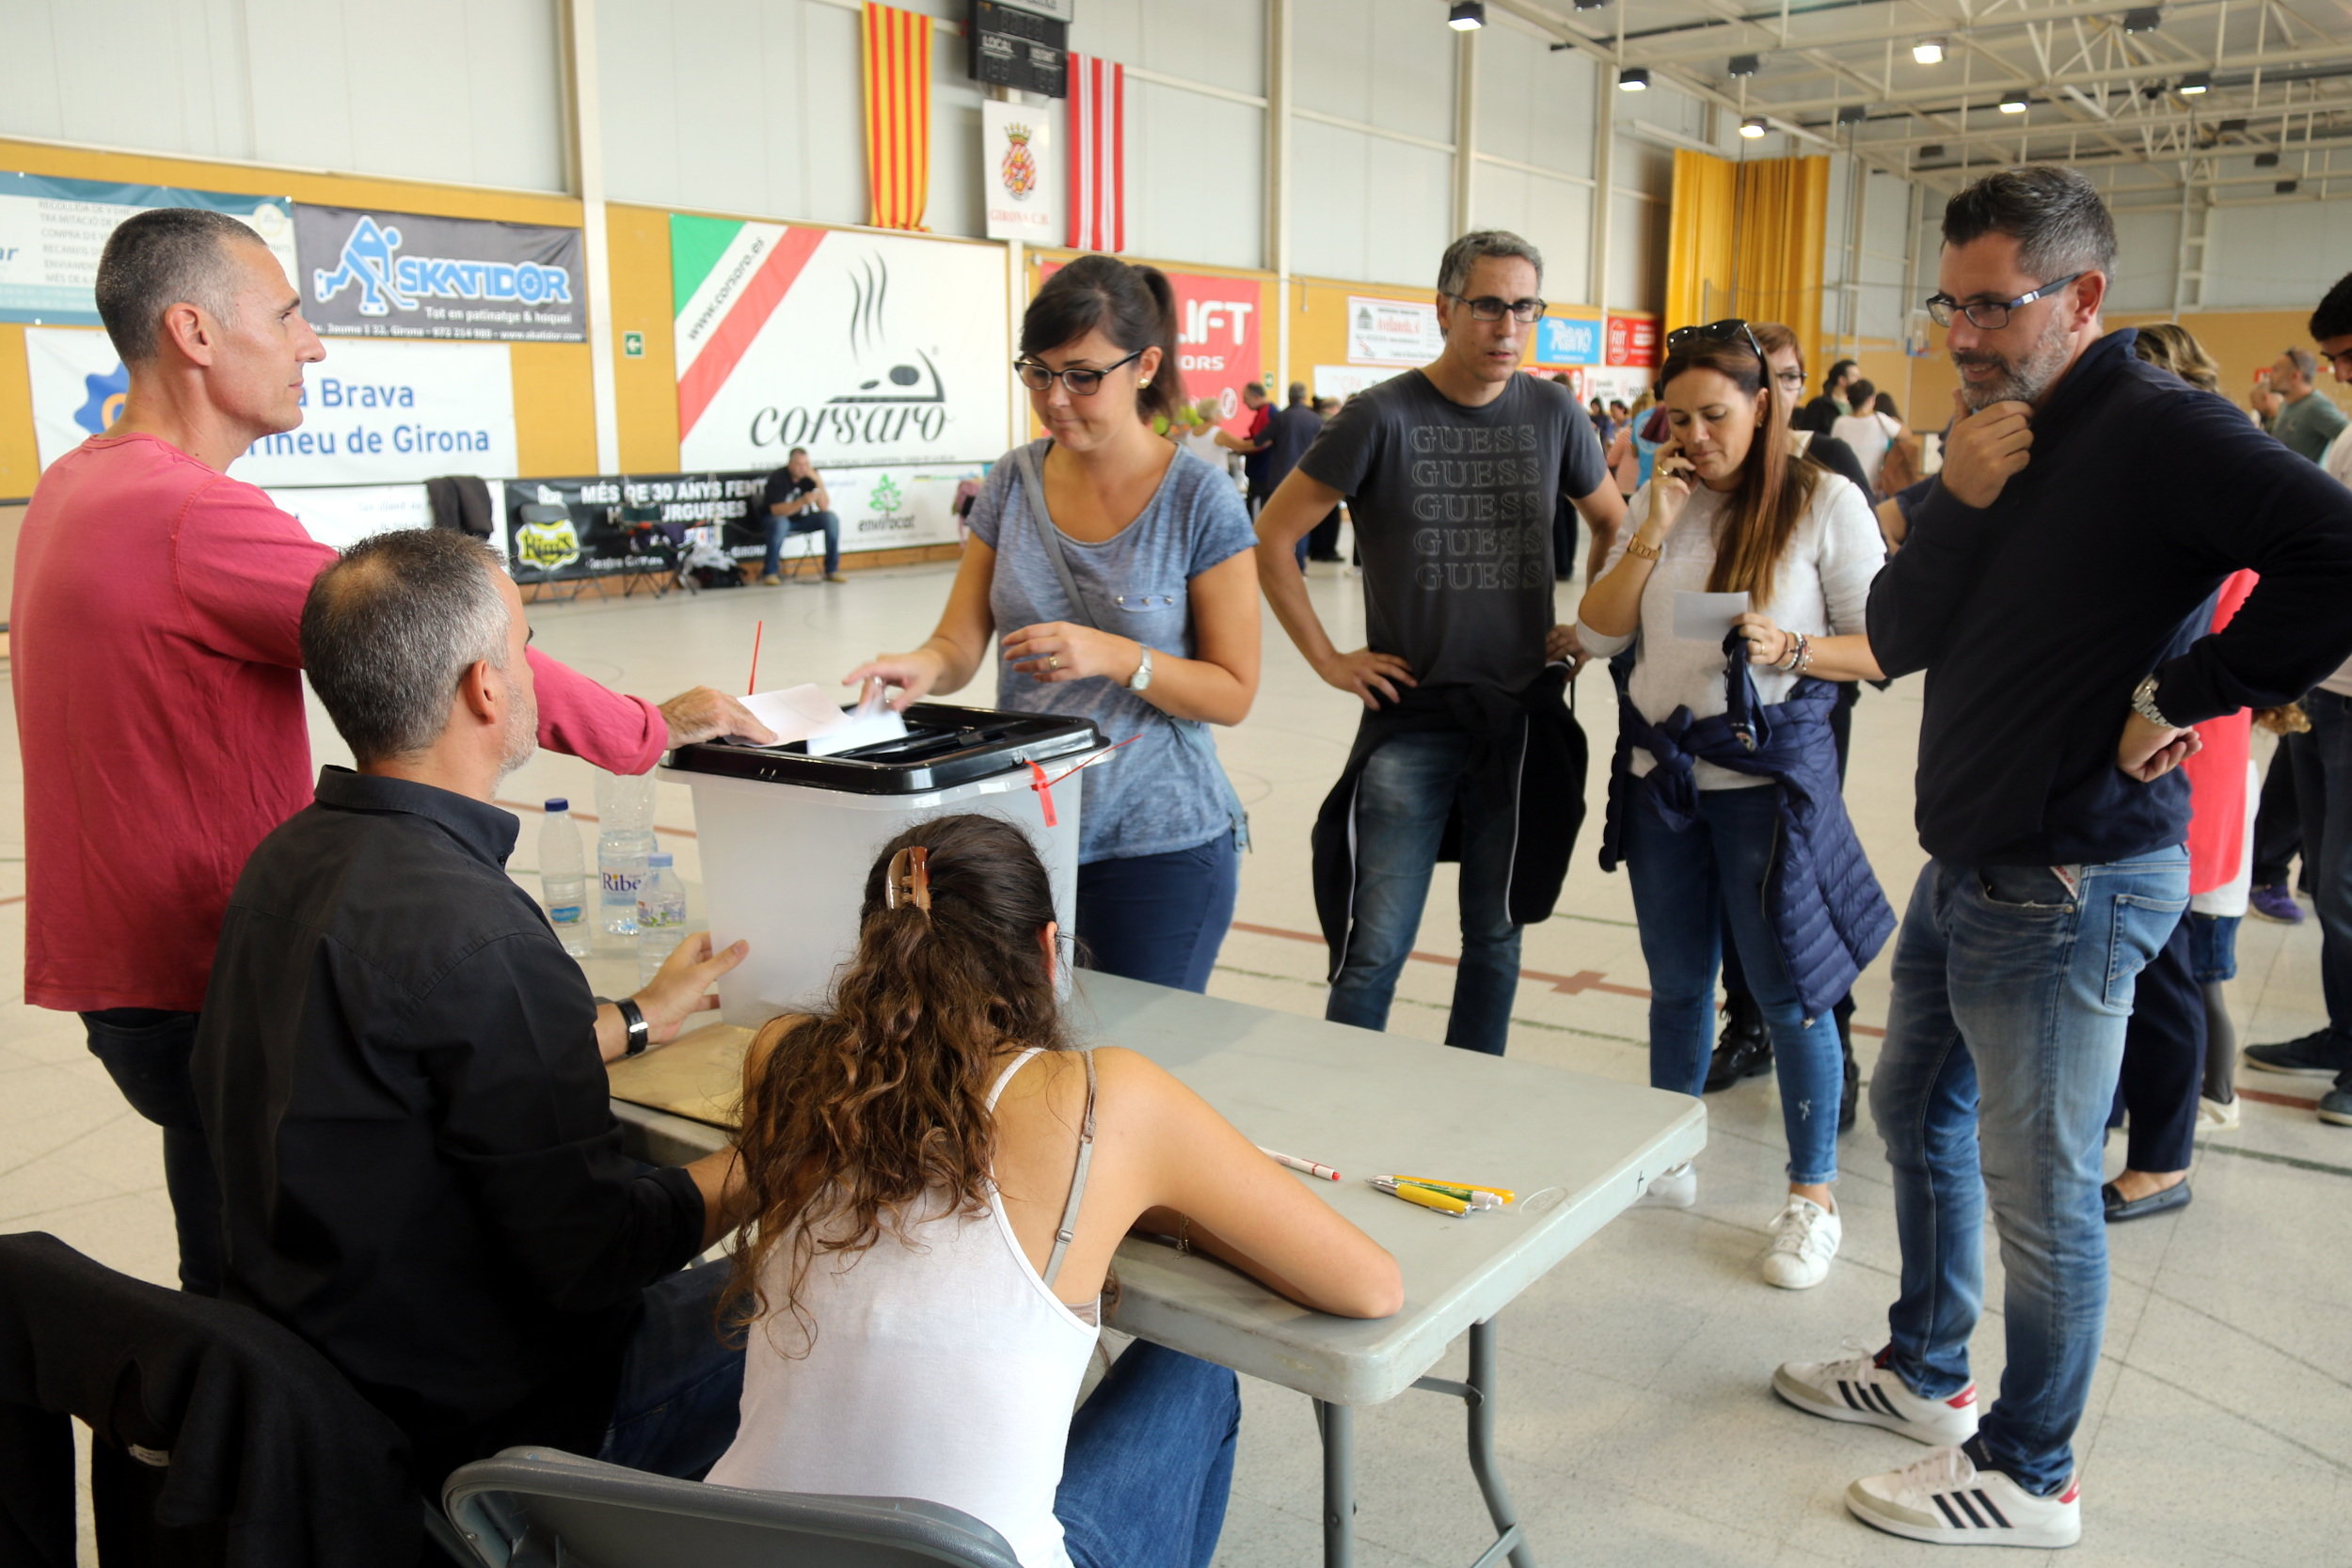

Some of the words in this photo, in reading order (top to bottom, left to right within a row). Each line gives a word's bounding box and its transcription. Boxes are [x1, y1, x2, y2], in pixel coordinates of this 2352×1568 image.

[982, 35, 1013, 55] LOCAL
[991, 208, 1026, 223] GIRONA
[396, 256, 573, 304] SKATIDOR
[688, 237, 765, 341] www.corsaro.es
[424, 306, 447, 320] Tot
[448, 309, 464, 321] en
[465, 309, 521, 325] patinatge
[523, 310, 532, 323] &
[534, 311, 573, 325] hoquei
[1178, 299, 1253, 346] IFT
[327, 323, 363, 335] Jaume
[389, 325, 424, 337] Girona
[500, 329, 582, 341] www.skatidor.com
[322, 378, 415, 407] Brava
[347, 426, 384, 454] de
[393, 424, 490, 453] Girona
[750, 404, 948, 447] corsaro
[1410, 424, 1537, 453] GUESS
[1411, 457, 1541, 487] GUESS
[580, 480, 621, 504] MÉS
[652, 483, 674, 501] 30
[676, 481, 723, 500] ANYS
[1412, 491, 1543, 521] GUESS
[1413, 525, 1543, 556] GUESS
[1415, 561, 1544, 591] GUESS
